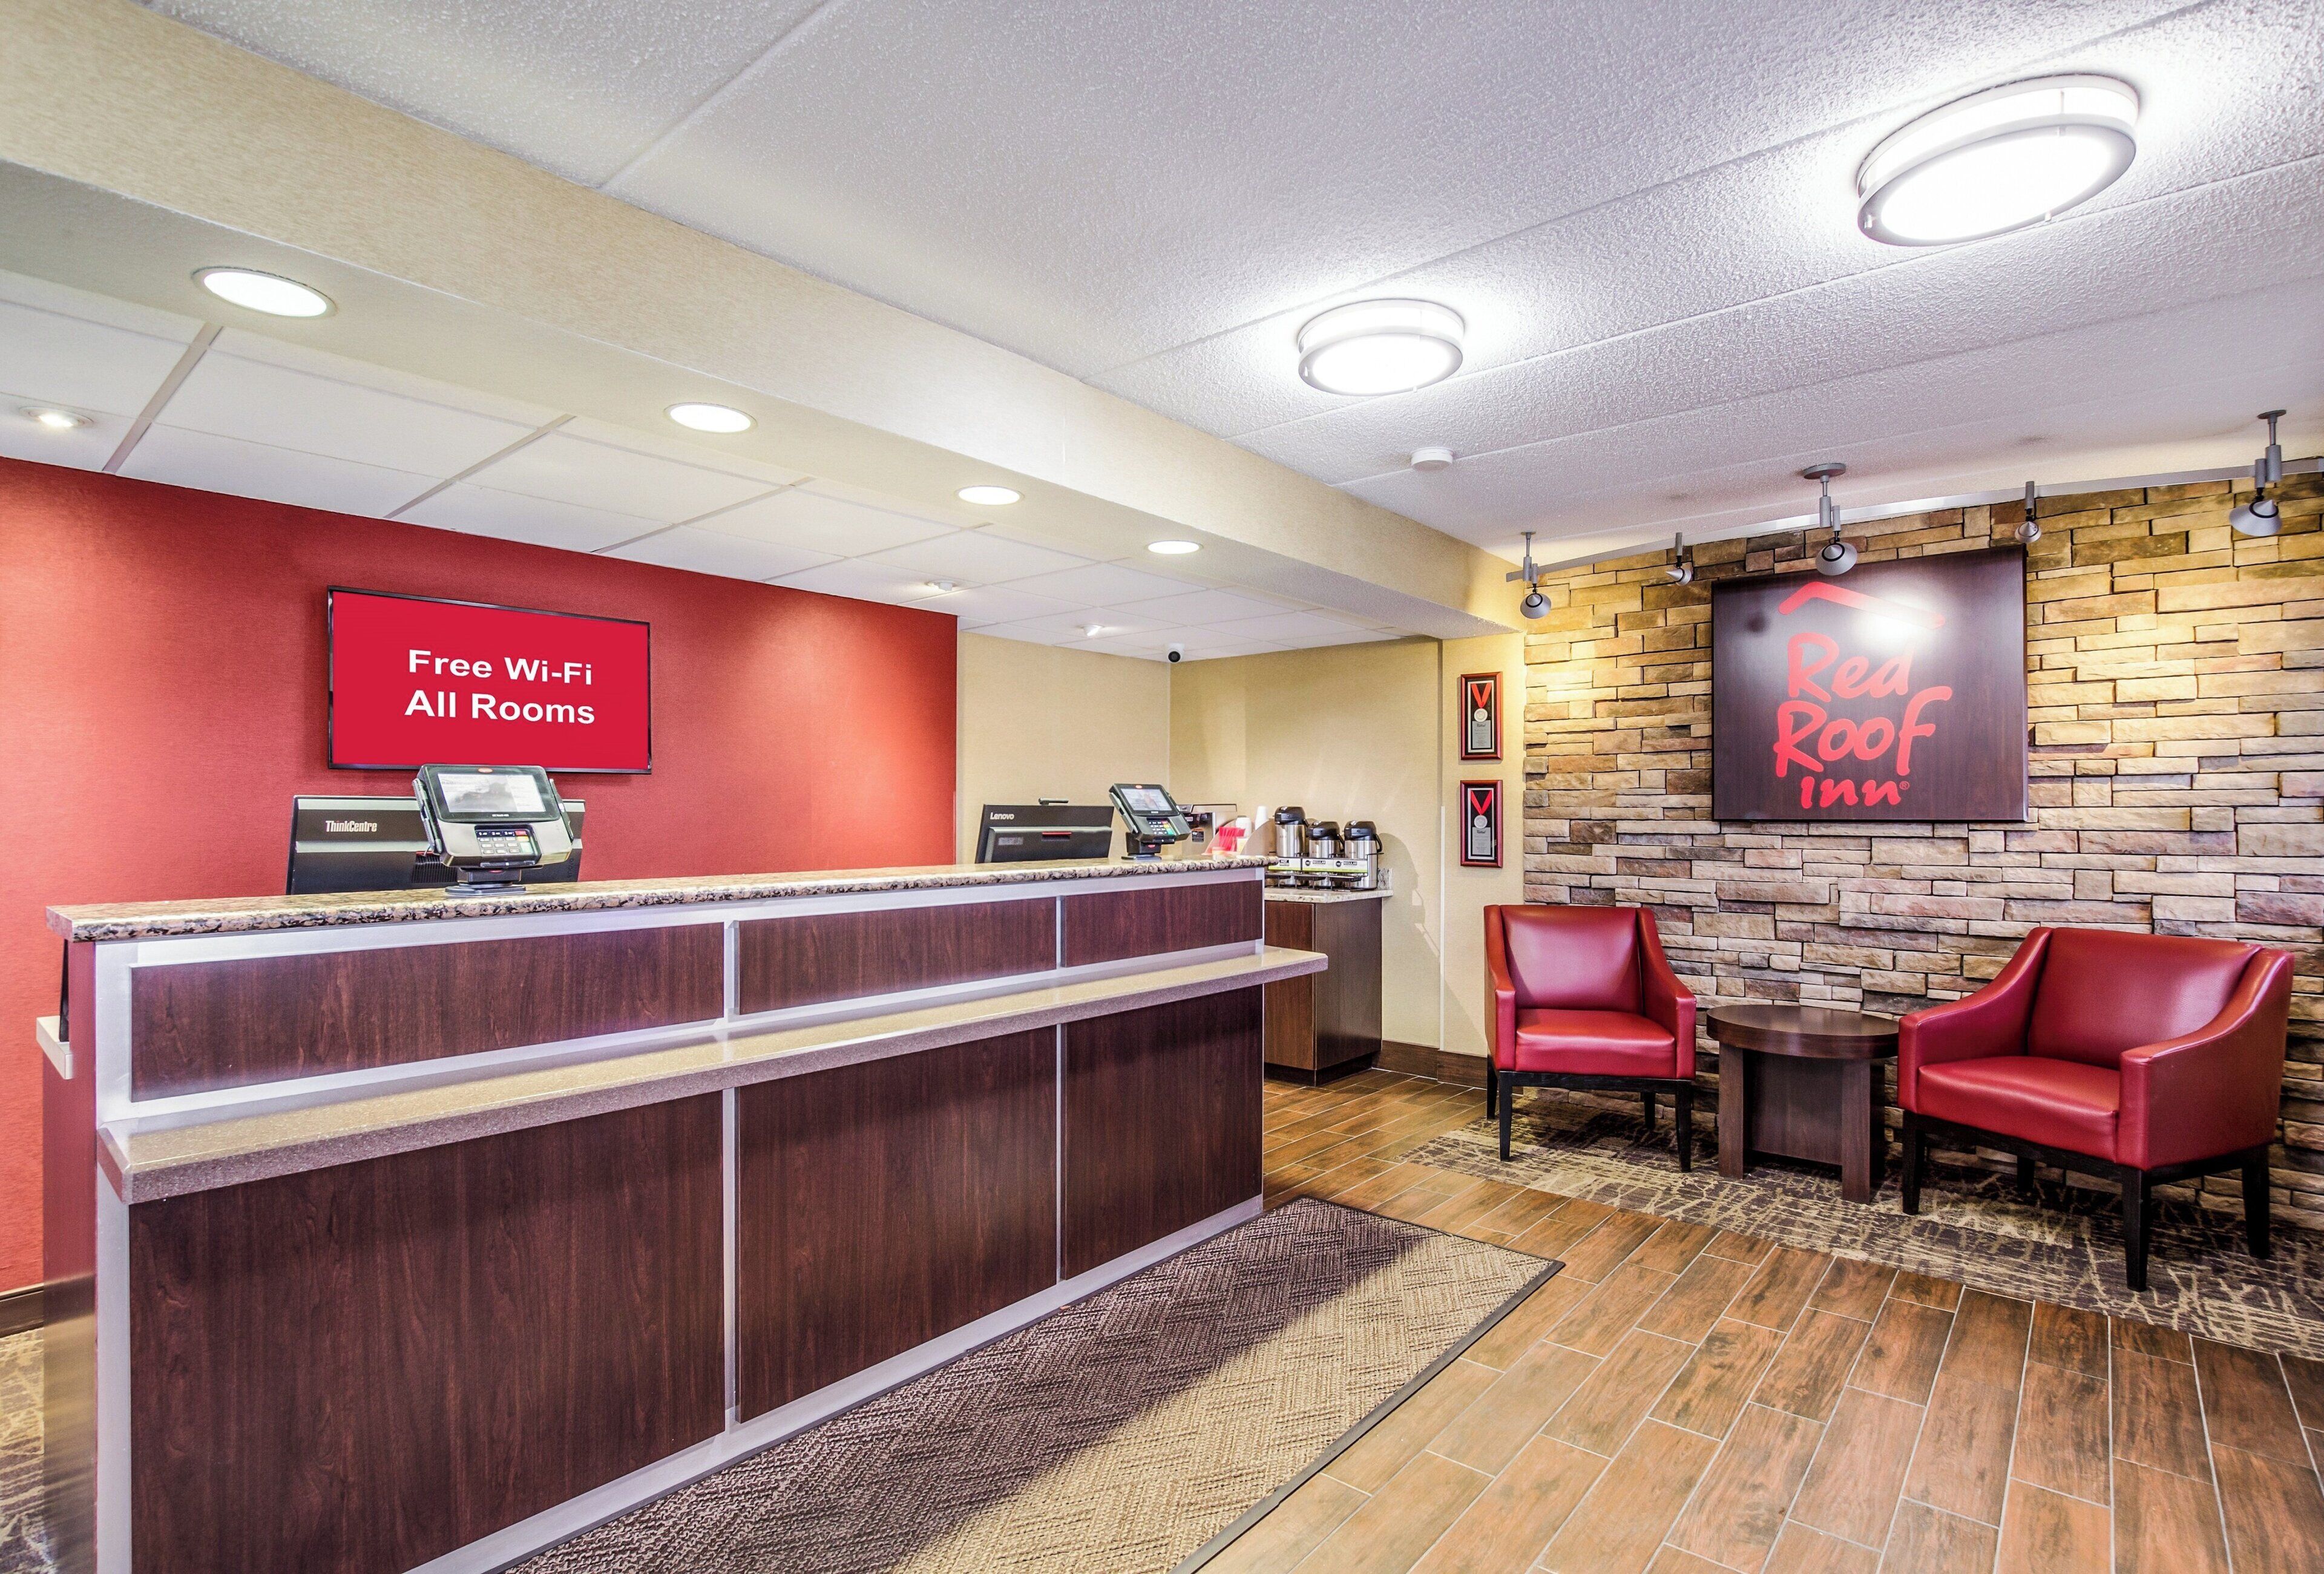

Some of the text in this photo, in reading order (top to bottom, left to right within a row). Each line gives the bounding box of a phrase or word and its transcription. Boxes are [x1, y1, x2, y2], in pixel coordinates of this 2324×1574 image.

[409, 649, 592, 685] Free Wi-Fi
[1787, 632, 1917, 703] Red
[404, 689, 596, 725] All Rooms
[1772, 686, 1953, 778] Roof
[325, 820, 378, 832] ThinkCentre
[990, 812, 1015, 820] Lenovo
